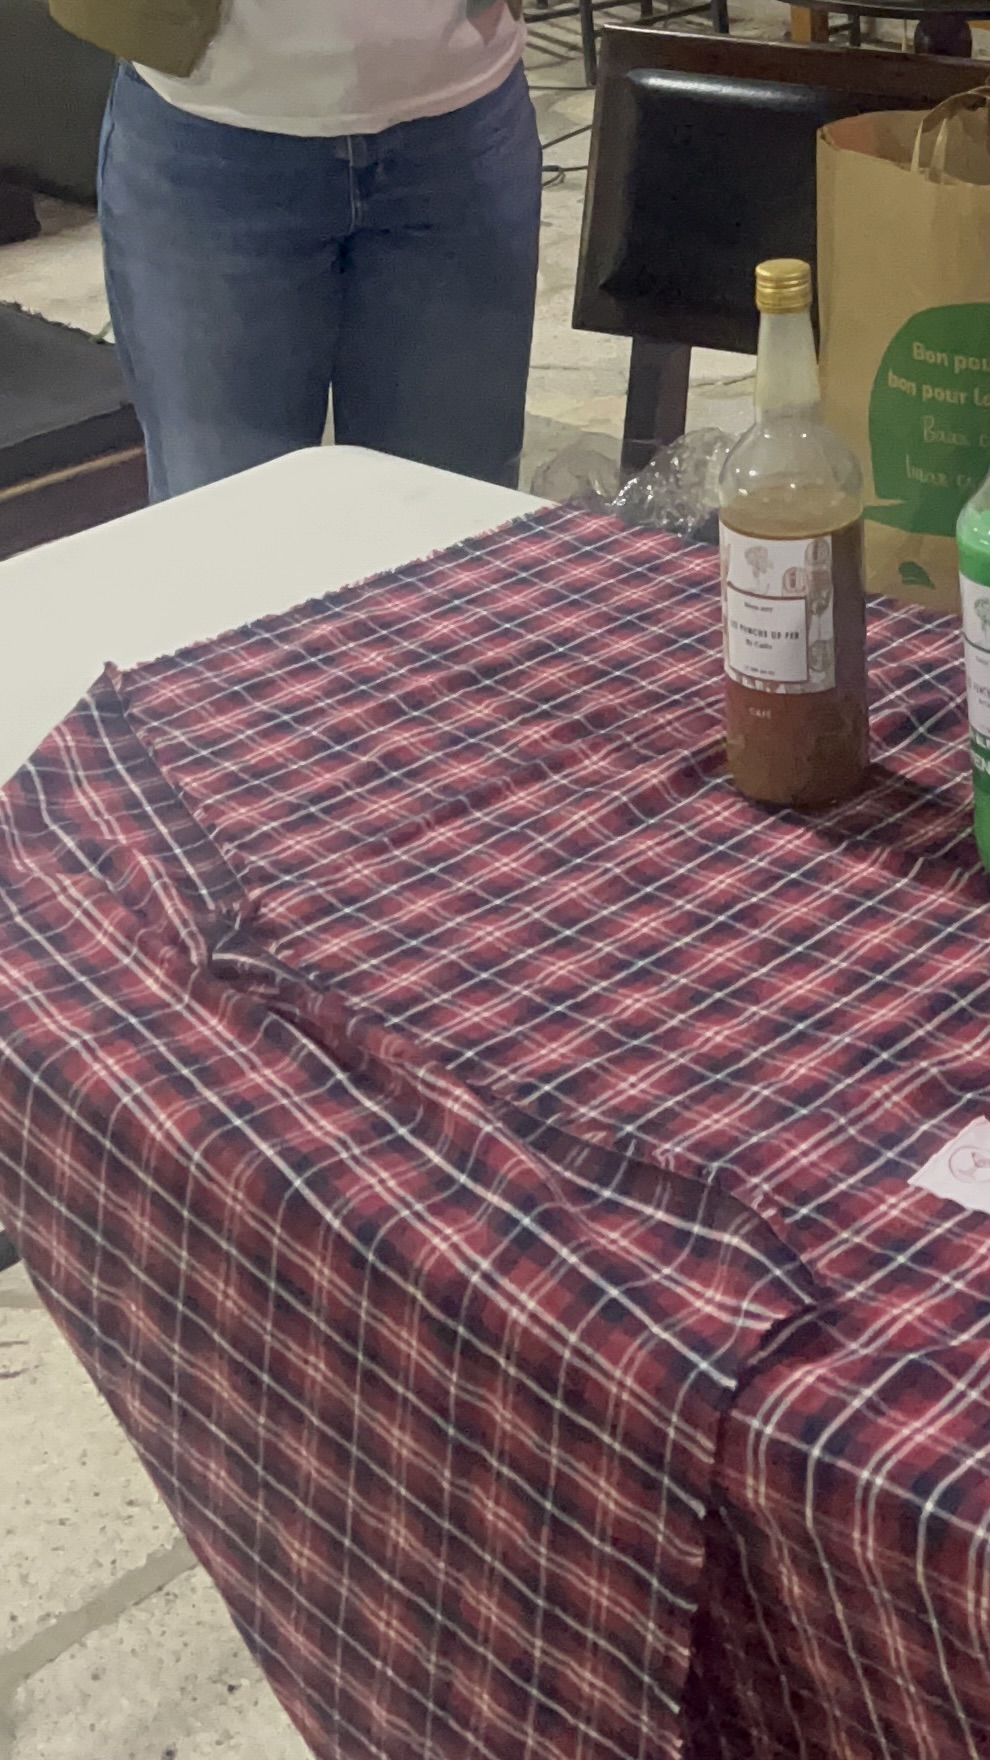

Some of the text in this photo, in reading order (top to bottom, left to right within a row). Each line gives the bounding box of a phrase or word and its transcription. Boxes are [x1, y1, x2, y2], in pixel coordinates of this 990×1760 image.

[912, 341, 949, 367] Bon
[887, 369, 916, 396] bon
[922, 383, 968, 405] pour
